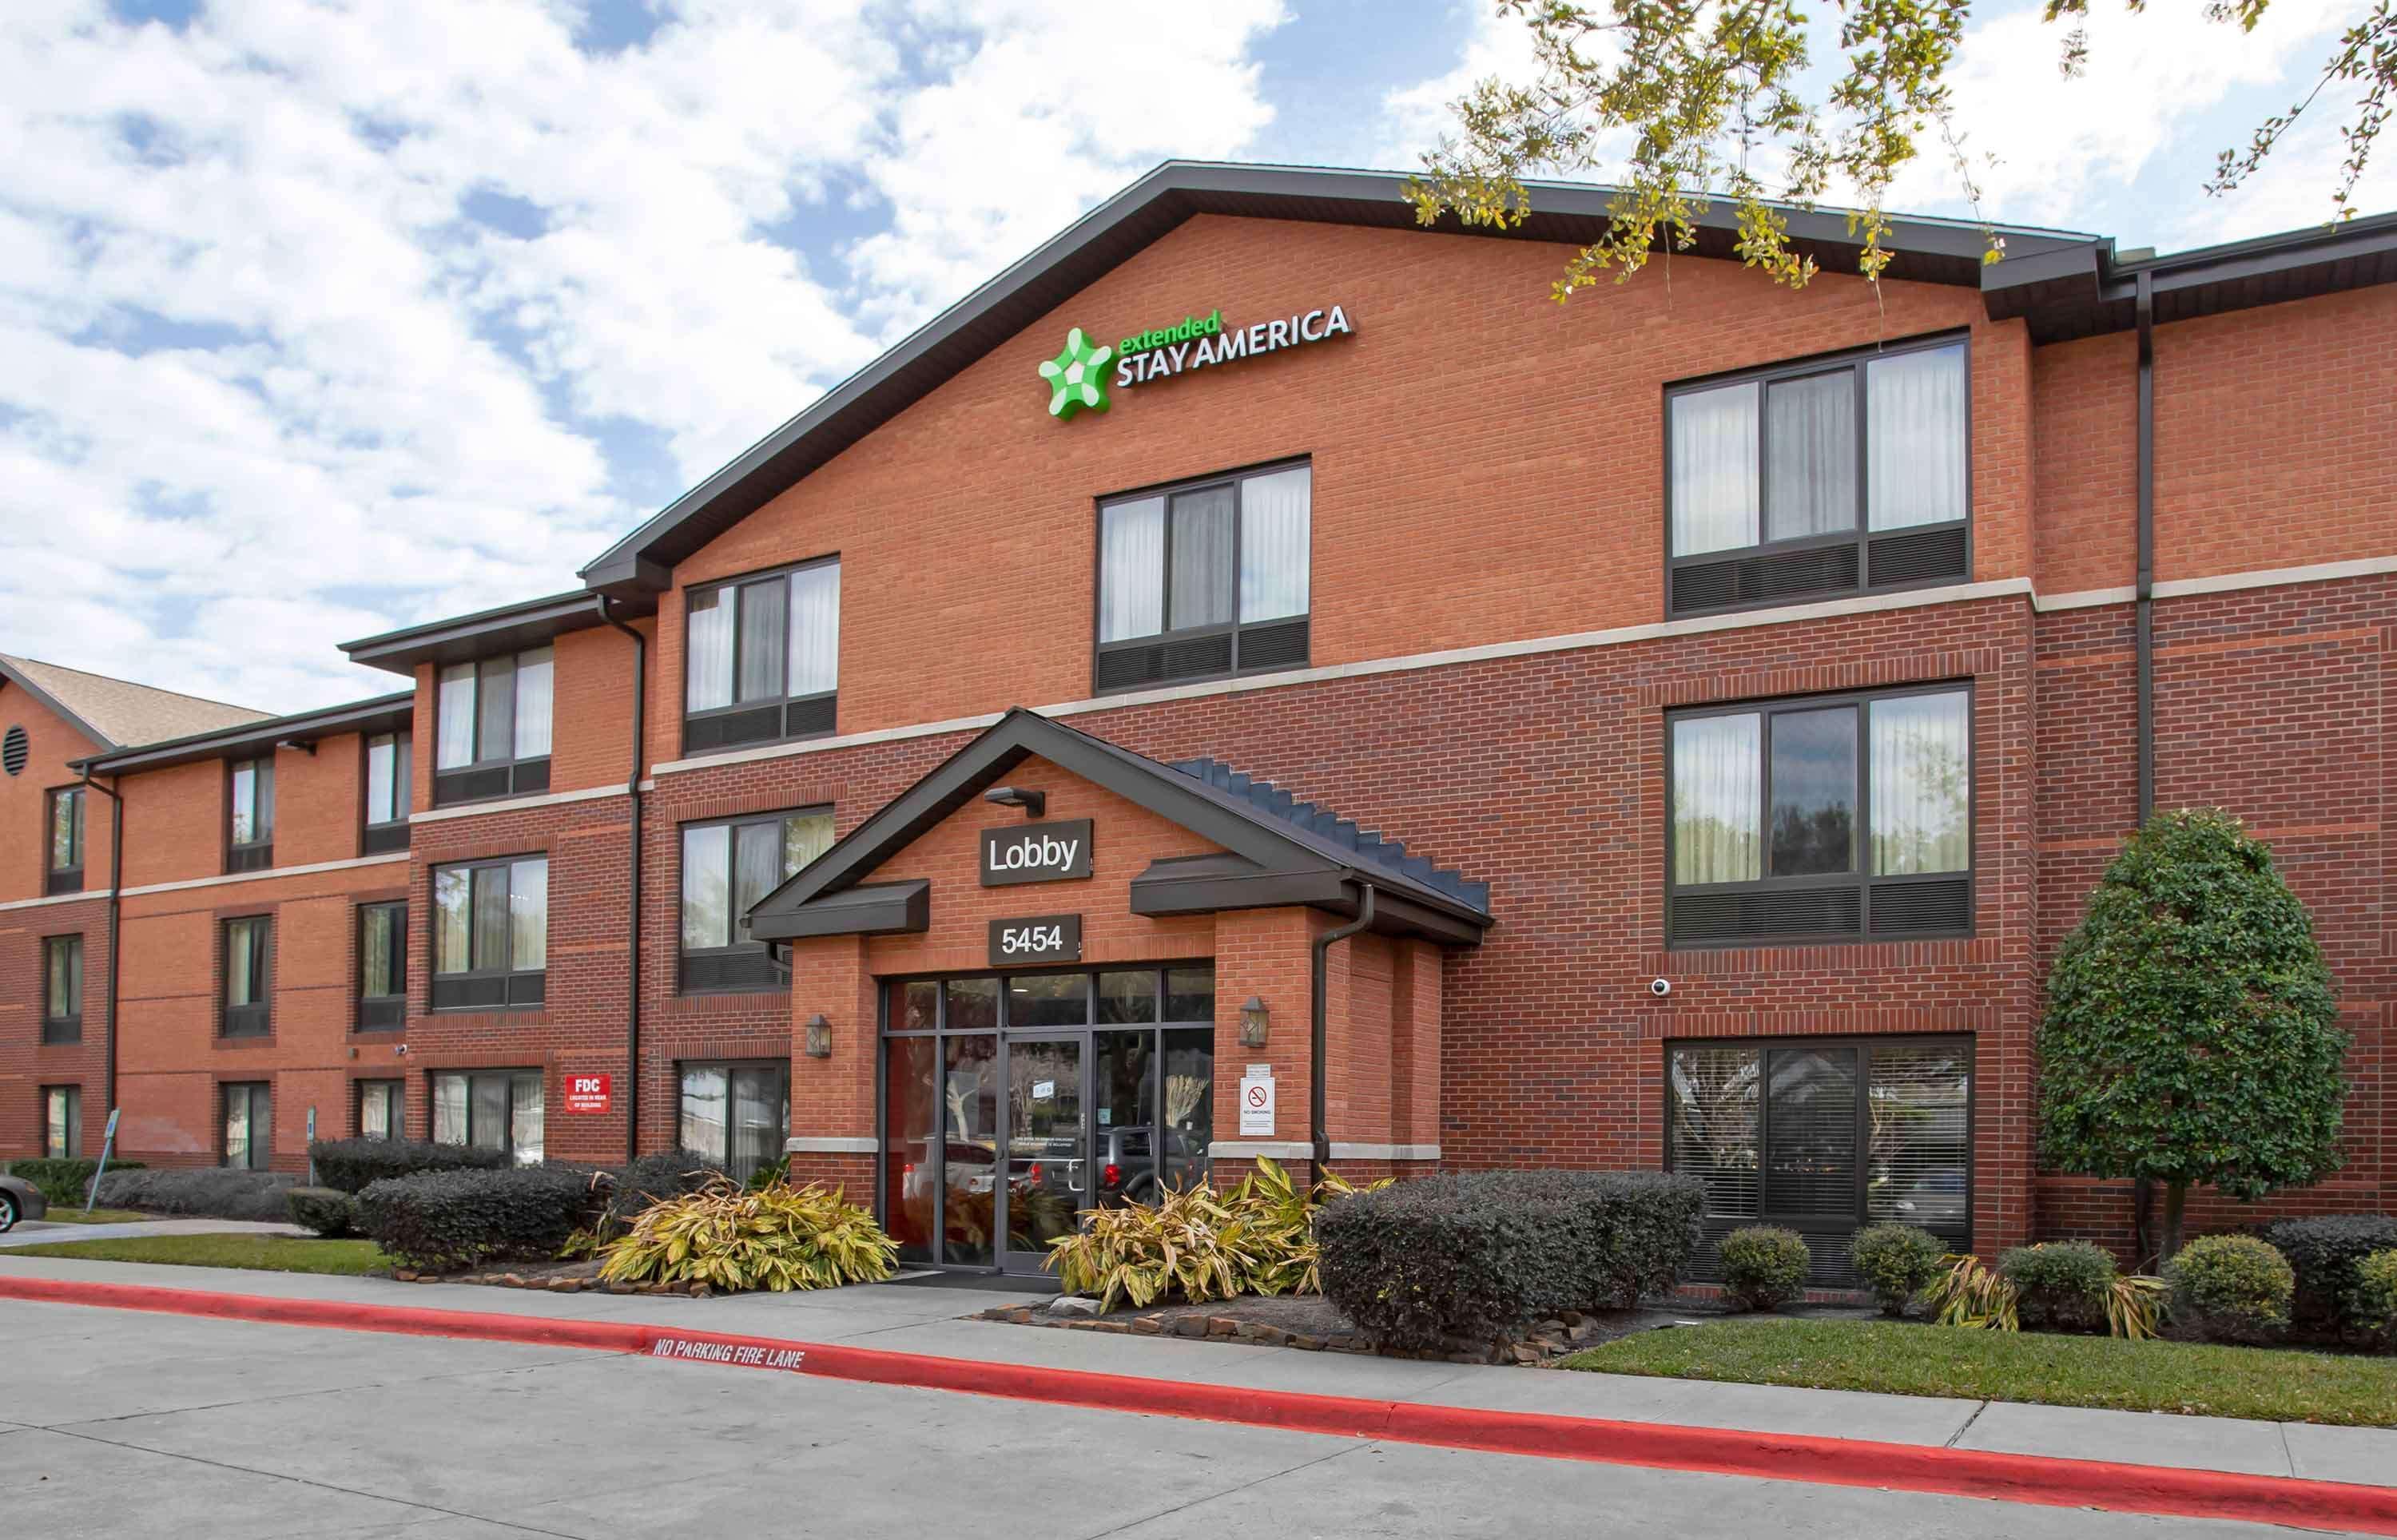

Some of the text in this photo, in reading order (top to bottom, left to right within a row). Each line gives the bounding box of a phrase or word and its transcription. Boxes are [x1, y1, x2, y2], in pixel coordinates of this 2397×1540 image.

[1116, 305, 1353, 387] STAY AMERICA
[1119, 309, 1221, 355] extended
[990, 835, 1079, 871] Lobby
[1002, 925, 1063, 954] 5454
[575, 1078, 600, 1093] FDC
[653, 1338, 806, 1368] NO PARKING FIRE LANE
